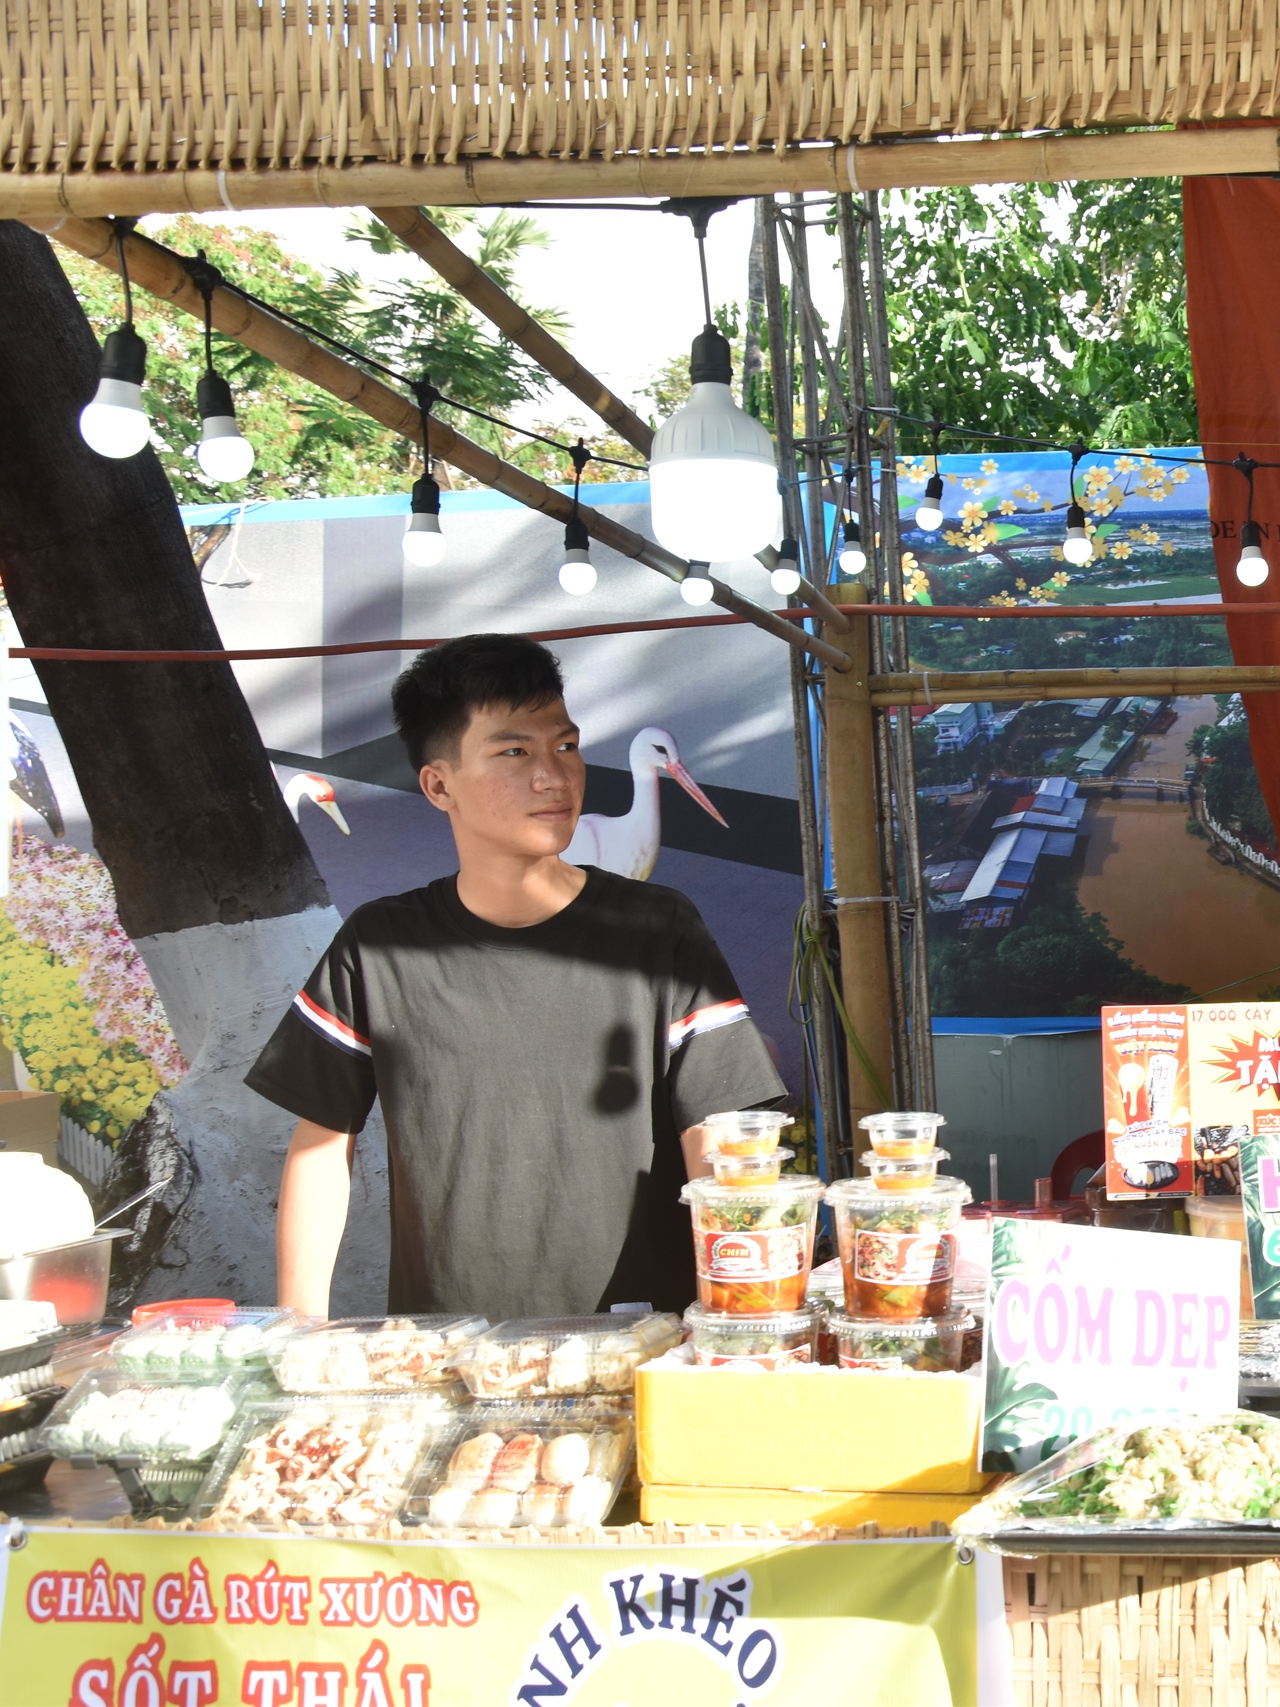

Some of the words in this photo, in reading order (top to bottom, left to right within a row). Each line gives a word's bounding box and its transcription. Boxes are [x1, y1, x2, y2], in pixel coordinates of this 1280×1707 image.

[996, 1244, 1115, 1366] CỐM
[1131, 1289, 1232, 1393] DẸP
[28, 1560, 144, 1622] CHÂN
[155, 1560, 216, 1623] GÀ
[226, 1561, 310, 1624] RÚT
[321, 1574, 478, 1626] XƯƠNG
[608, 1572, 778, 1689] KHÉO
[72, 1634, 217, 1707] SỐT
